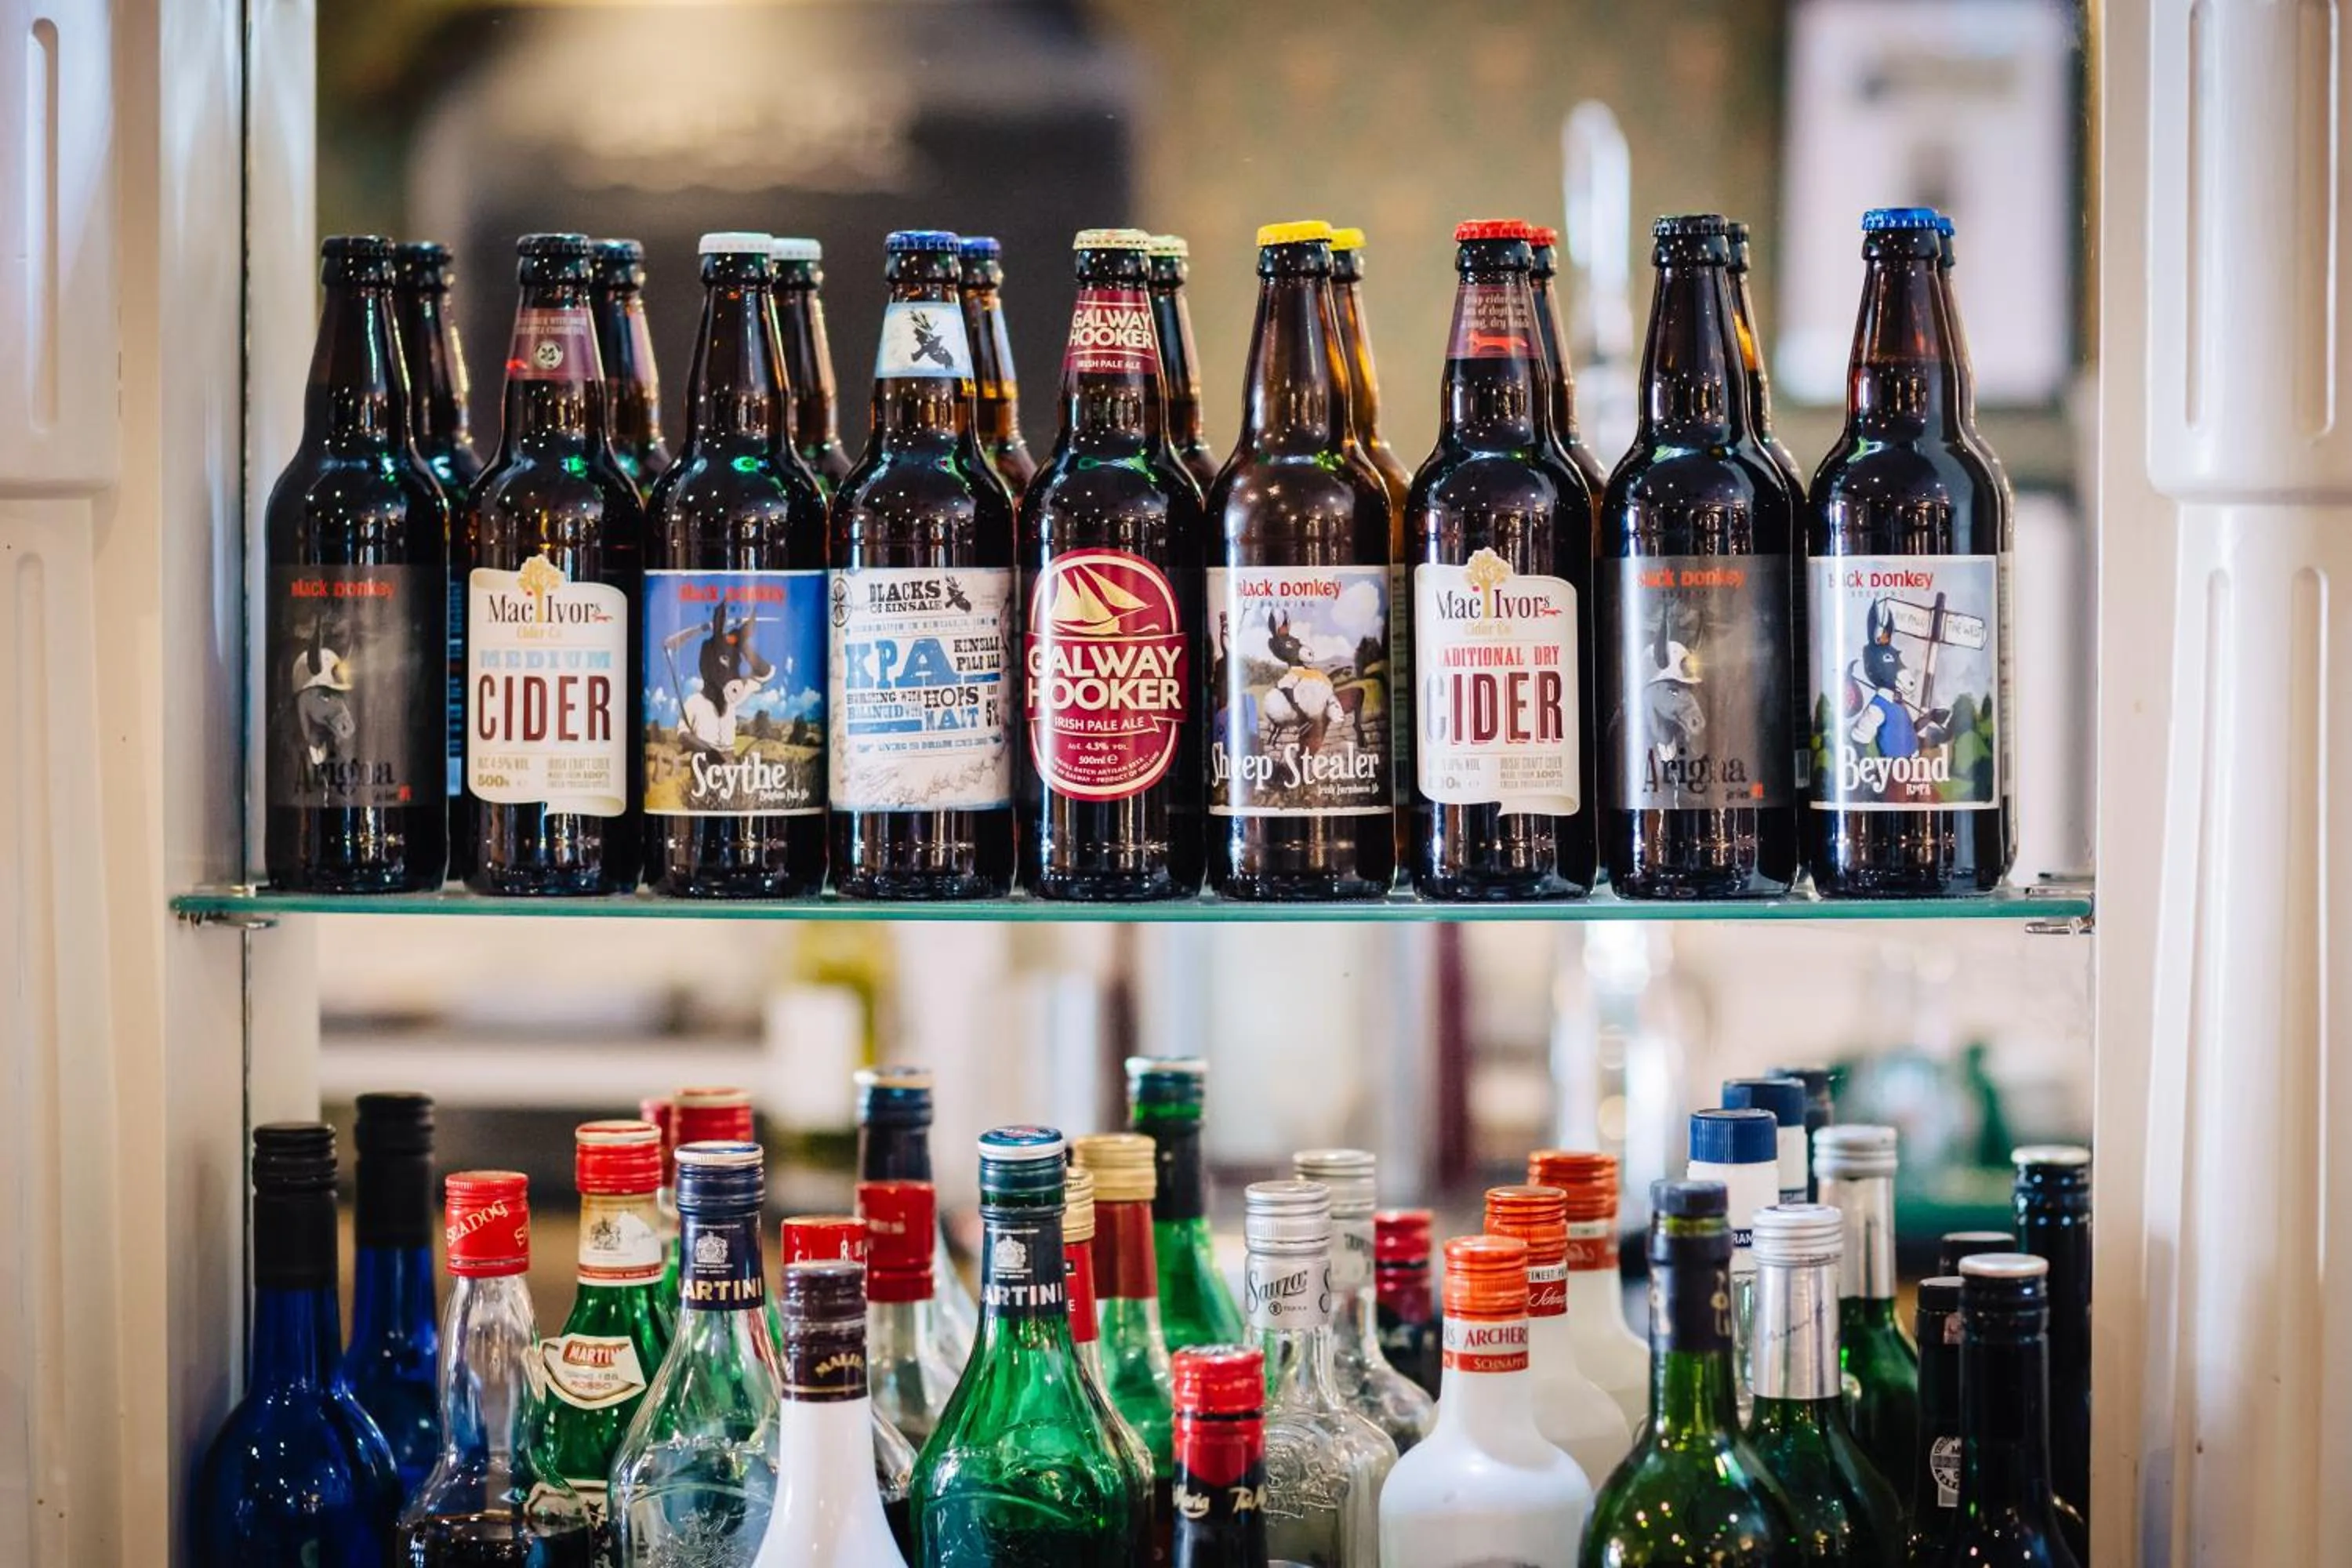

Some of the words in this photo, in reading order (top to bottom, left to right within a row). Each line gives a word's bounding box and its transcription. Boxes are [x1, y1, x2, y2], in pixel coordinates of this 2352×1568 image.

[1073, 308, 1150, 330] GALWAY
[1069, 327, 1154, 350] HOOKER
[1100, 360, 1123, 368] PALE
[869, 579, 942, 603] BLACKS
[1436, 590, 1481, 619] Mac
[488, 593, 534, 623] Mac
[479, 649, 612, 669] MEDIUM
[845, 637, 962, 690] KPA
[1028, 645, 1182, 679] GALWAY
[1438, 646, 1524, 667] ADITIONAL
[1534, 645, 1559, 666] DRY
[923, 685, 979, 709] HOPS
[1028, 678, 1182, 710] HOOKER
[1425, 670, 1564, 744] CIDER
[477, 675, 612, 742] CIDER
[1054, 717, 1085, 730] IRISH
[1087, 720, 1118, 731] PALE
[1121, 716, 1145, 729] ALE
[1079, 755, 1106, 764] 500ml
[1283, 743, 1380, 789] Stealer
[1842, 743, 1950, 794] Beyond
[691, 752, 786, 800] Scythe
[982, 1283, 1063, 1308] ARTINI
